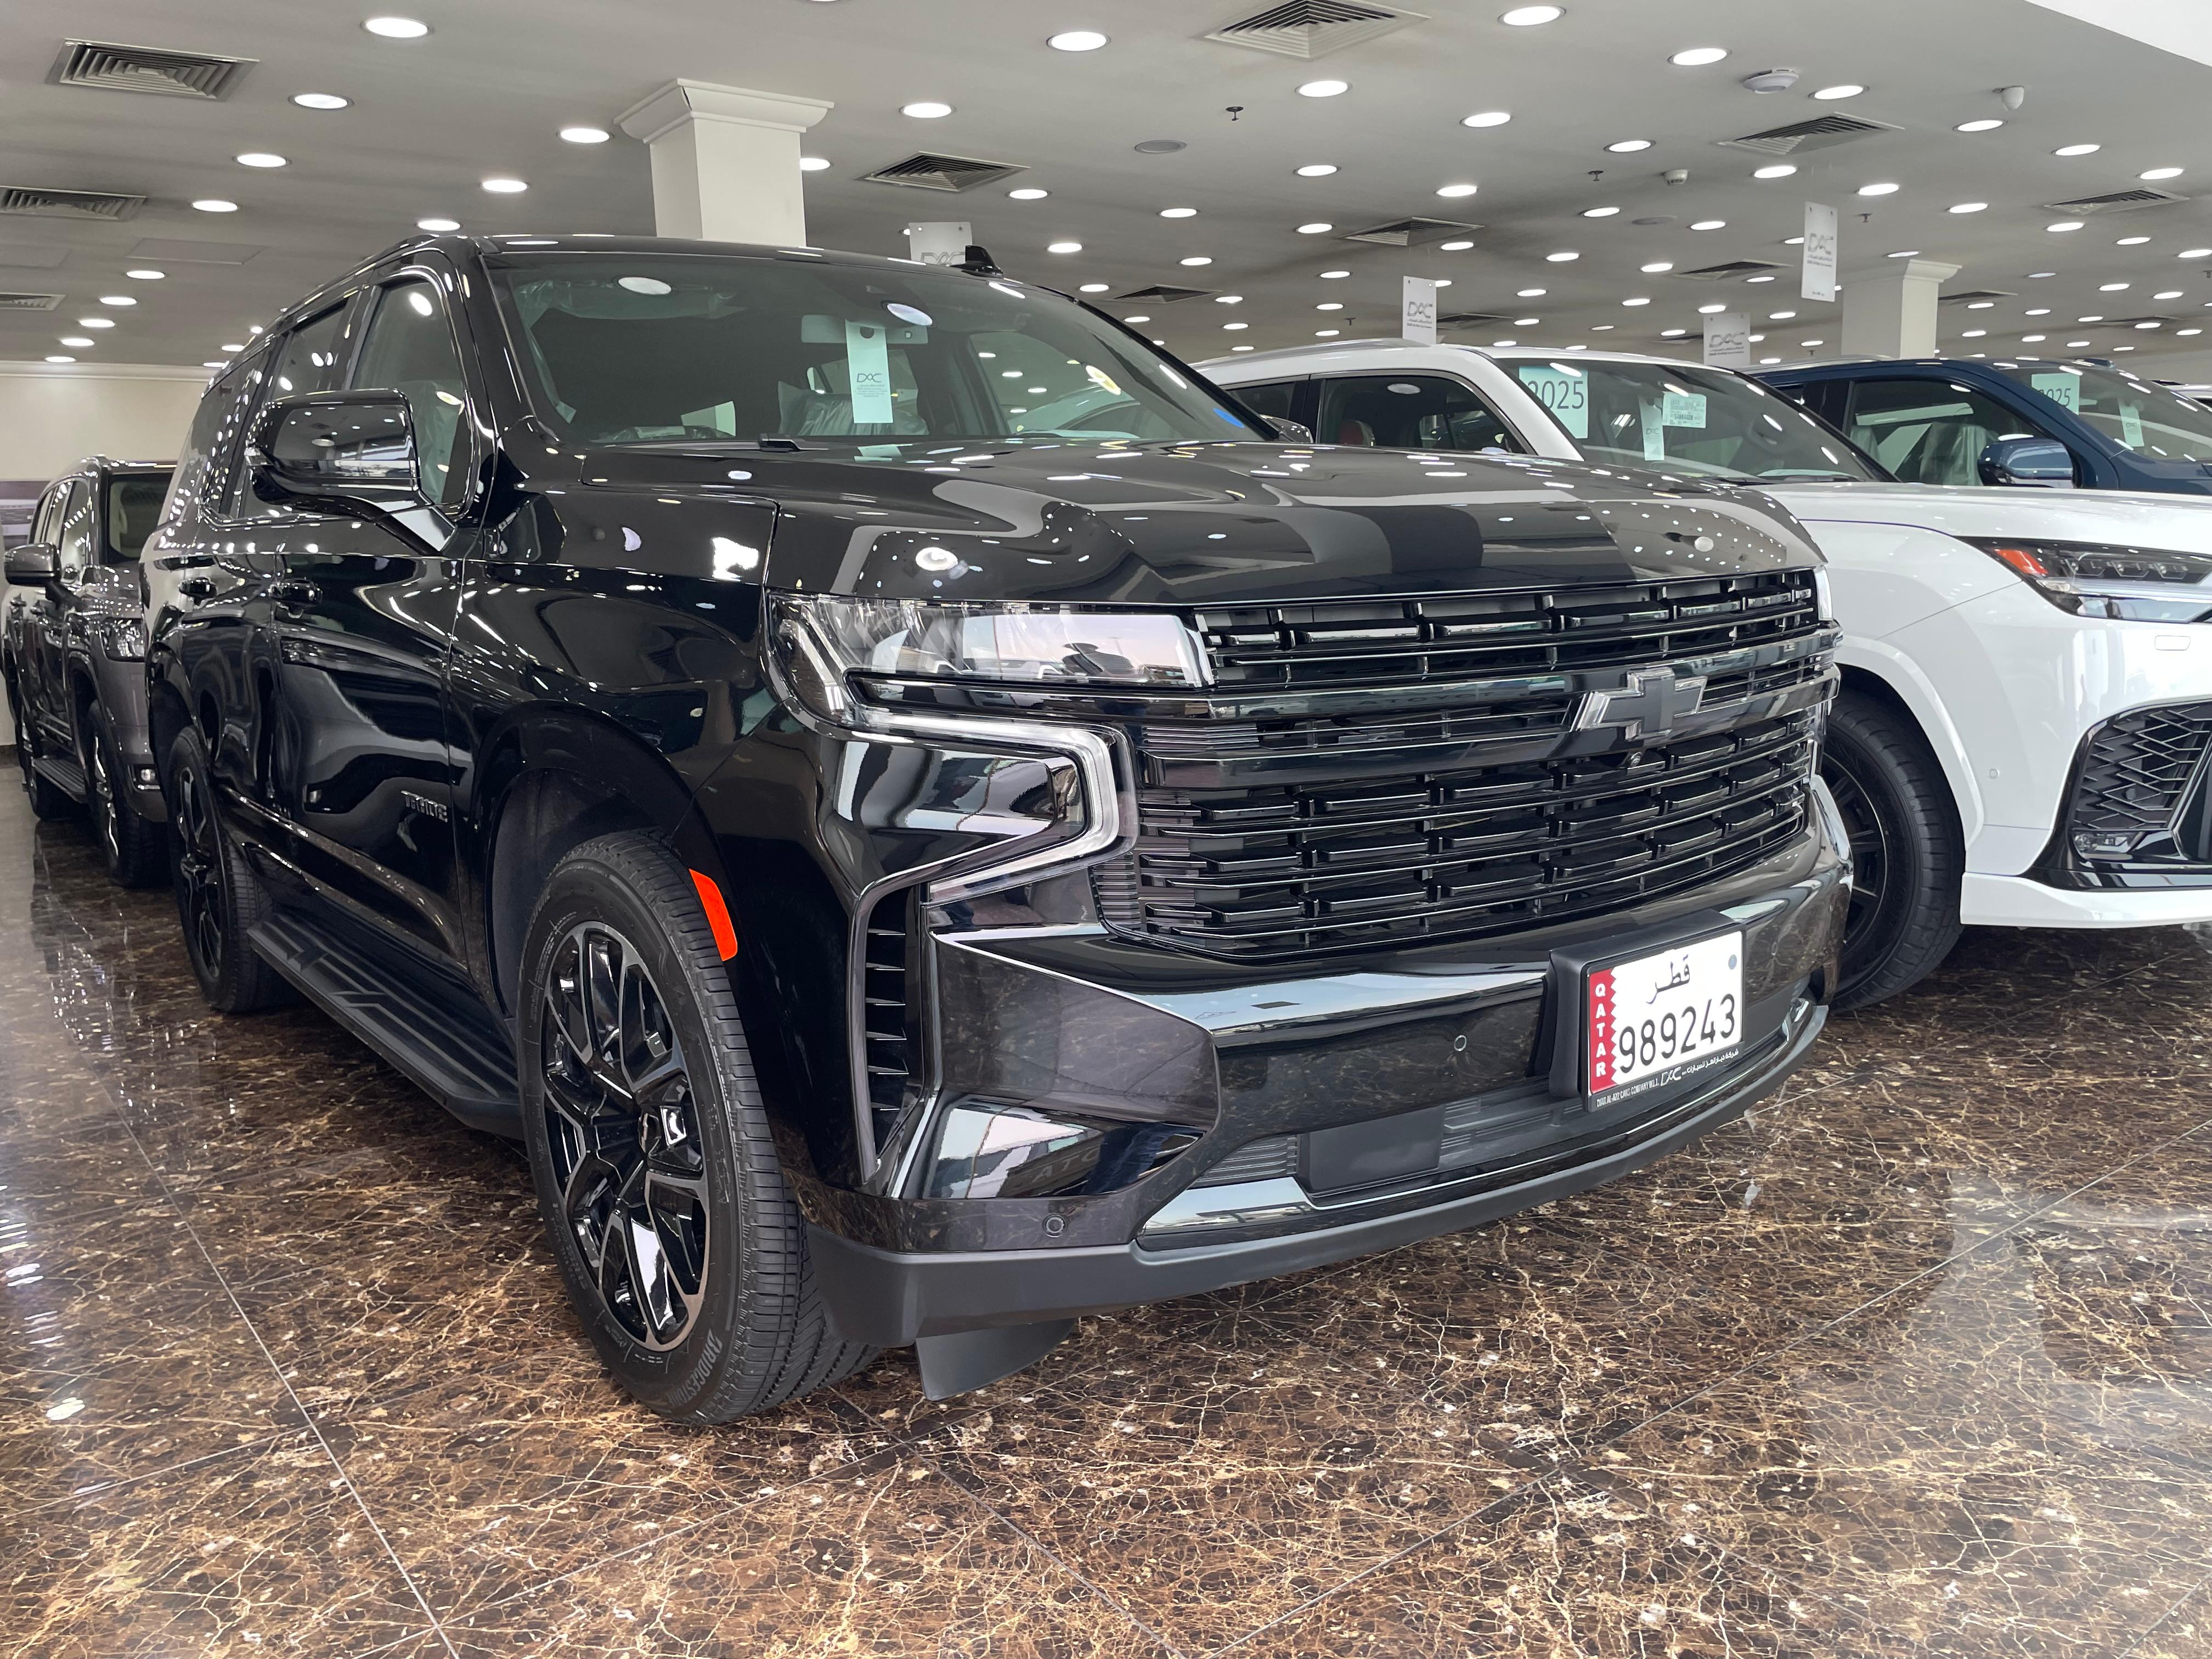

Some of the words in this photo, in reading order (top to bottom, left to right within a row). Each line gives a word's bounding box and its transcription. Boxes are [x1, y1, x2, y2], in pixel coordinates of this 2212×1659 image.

[2039, 388, 2072, 407] 025
[1646, 953, 1691, 1005] قطر
[1595, 983, 1607, 1077] QATAR
[1618, 993, 1736, 1074] 989243
